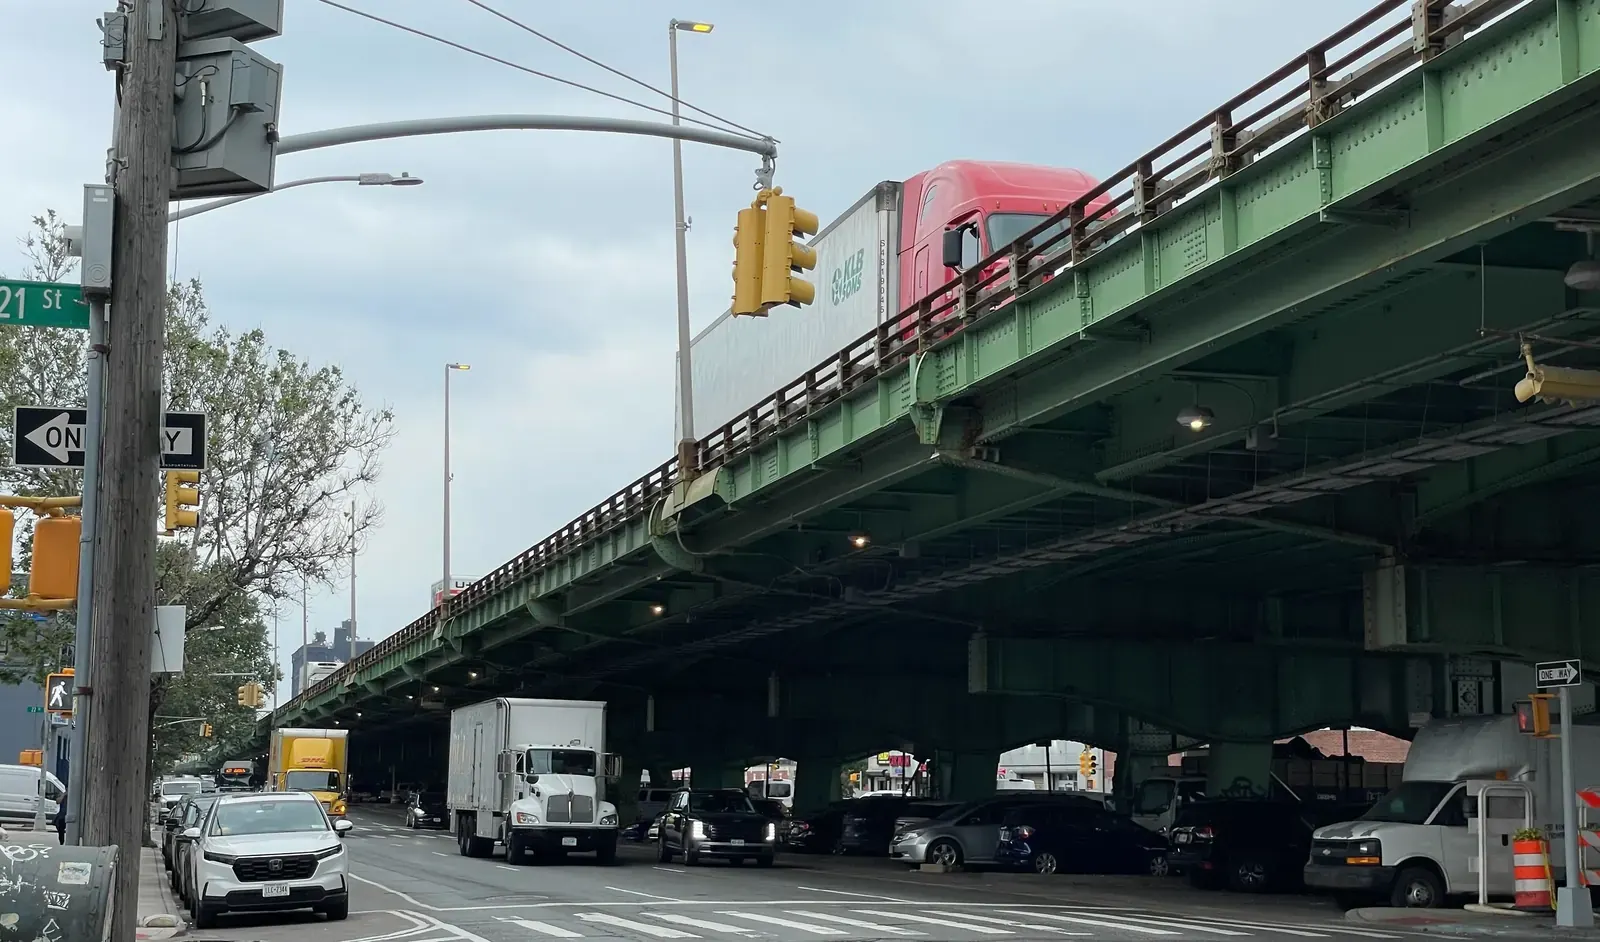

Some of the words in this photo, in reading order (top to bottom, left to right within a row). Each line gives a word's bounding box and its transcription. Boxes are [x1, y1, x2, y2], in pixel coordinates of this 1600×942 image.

[843, 248, 864, 282] KLB
[841, 272, 862, 302] SONS
[42, 289, 62, 309] St
[46, 426, 86, 448] ON
[1541, 670, 1553, 679] ONE
[1557, 669, 1571, 678] WAY
